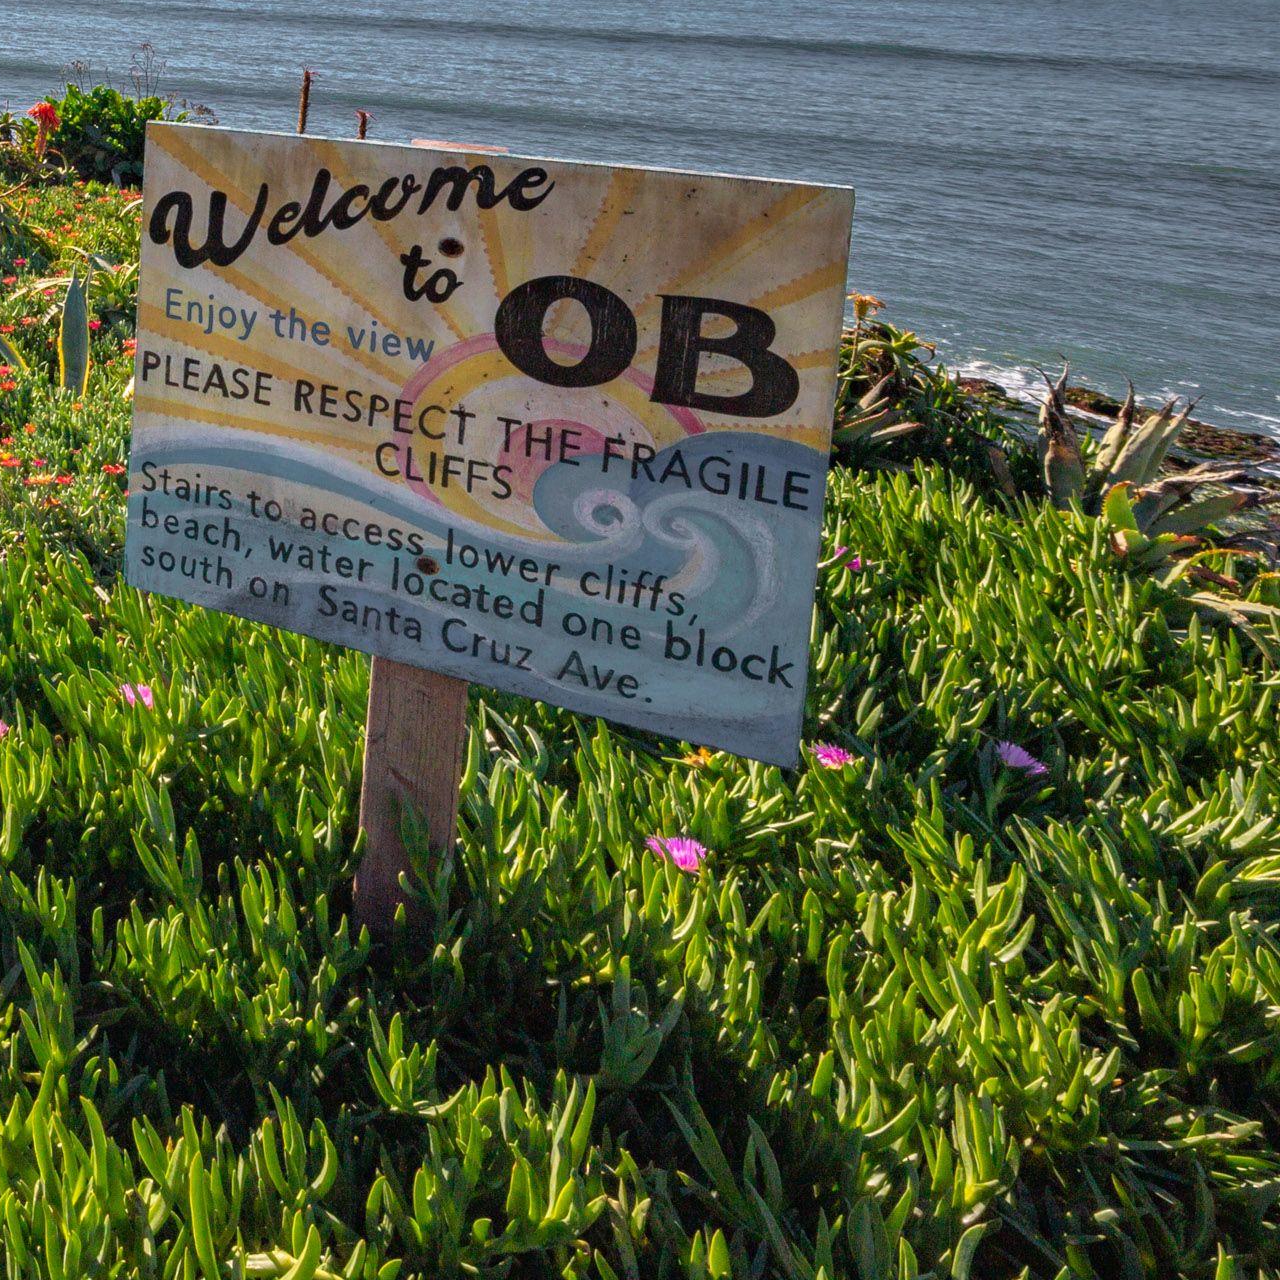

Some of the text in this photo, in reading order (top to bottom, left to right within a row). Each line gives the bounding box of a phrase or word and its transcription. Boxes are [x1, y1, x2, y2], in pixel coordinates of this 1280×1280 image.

[150, 165, 554, 269] Welcome
[399, 245, 463, 303] to
[165, 289, 435, 361] Enjoy the view
[494, 275, 799, 418] OB
[142, 351, 810, 511] PLEASE RESPECT THE FRAGILE
[376, 442, 512, 500] CLIFFS
[141, 462, 698, 625] Stairs to access lower cliffs,
[141, 498, 793, 689] beach, water located one block
[141, 542, 652, 703] south on Santa Cruz Ave.
